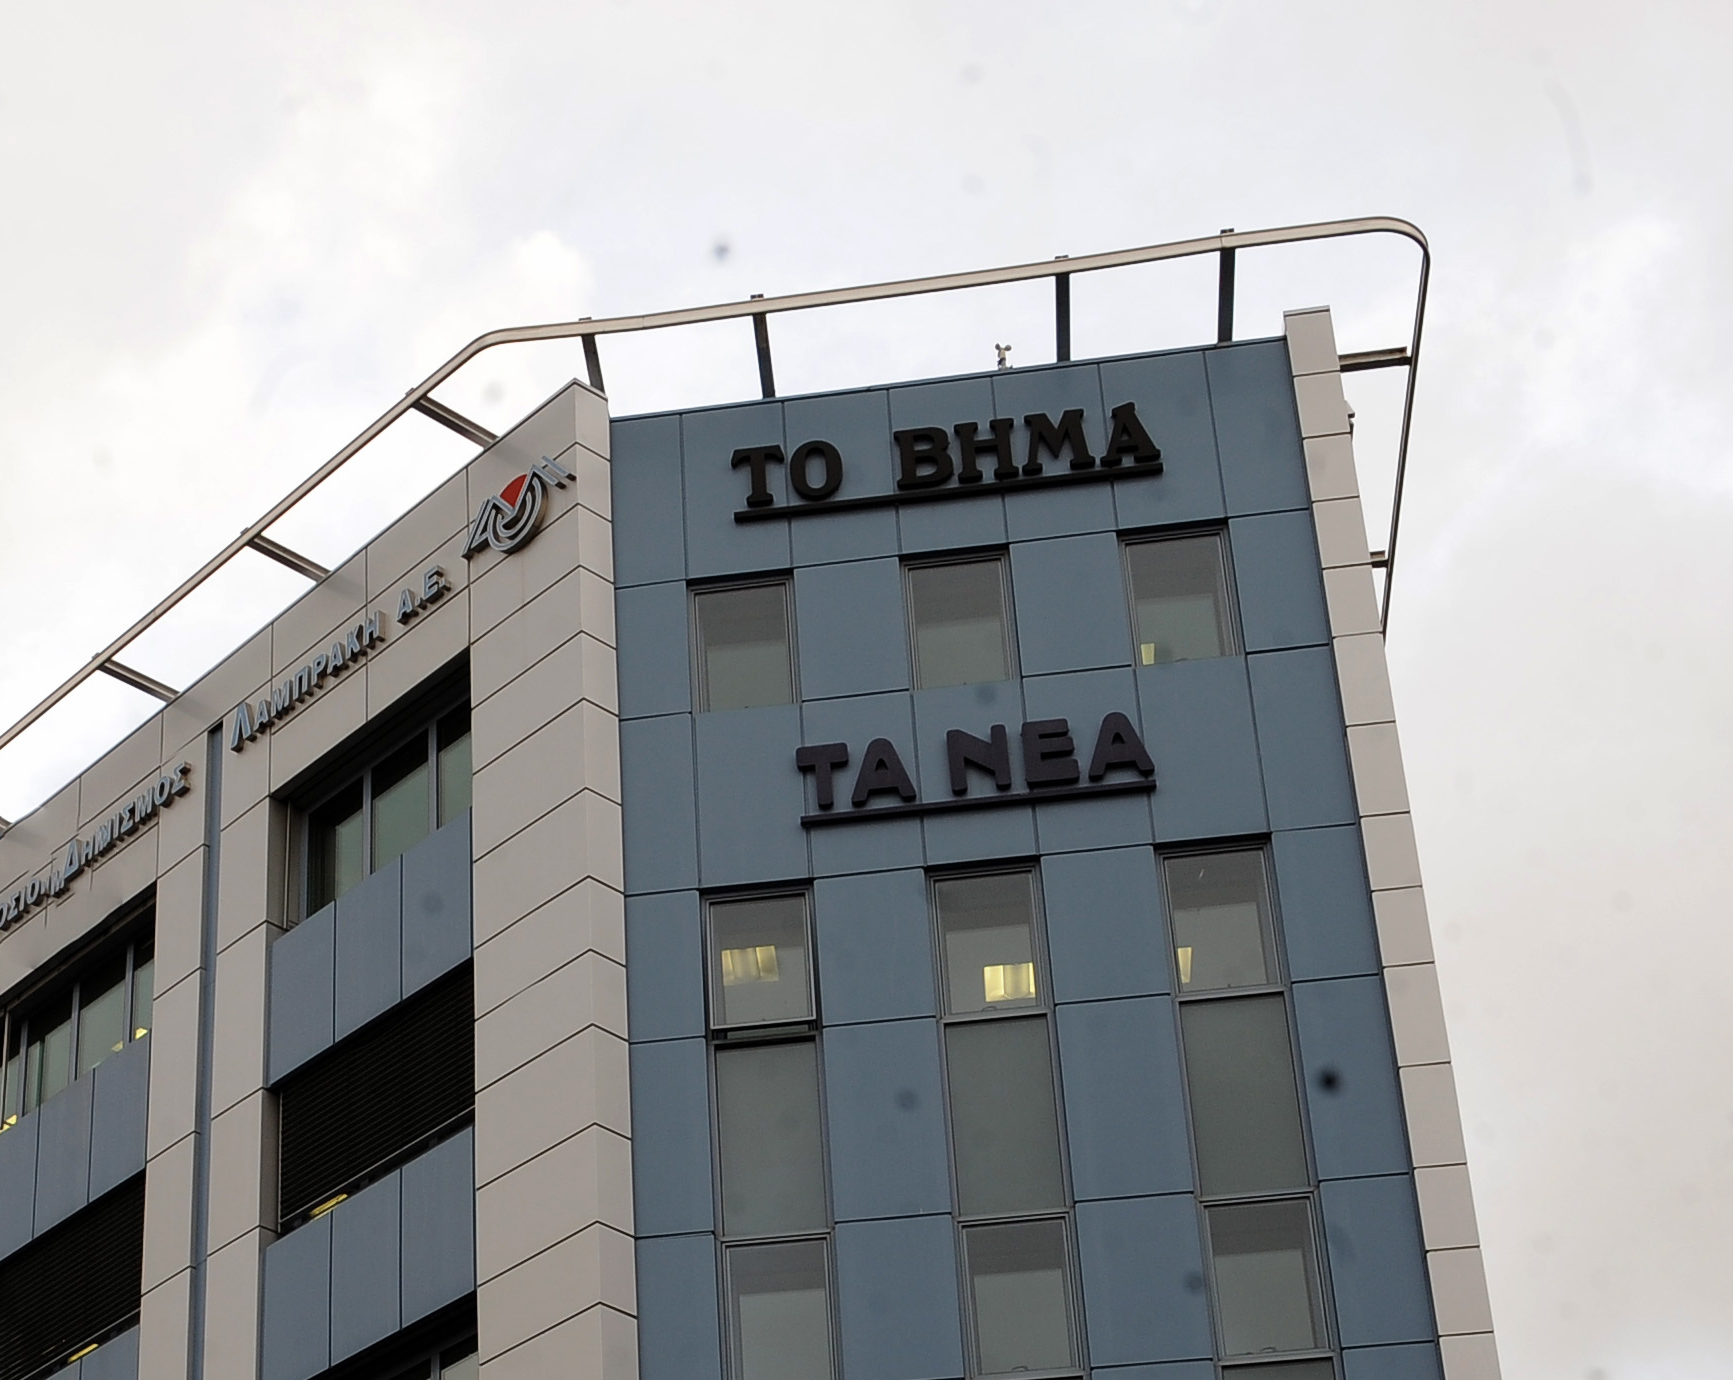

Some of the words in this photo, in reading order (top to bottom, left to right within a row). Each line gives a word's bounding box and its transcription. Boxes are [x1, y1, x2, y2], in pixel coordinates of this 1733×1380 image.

[730, 440, 843, 507] ΤΟ
[892, 402, 1162, 491] ΒΗΜΑ
[229, 609, 387, 753] ΛΑΜΠΡΑΚΗ
[397, 565, 451, 624] Α.Ε.
[795, 738, 917, 809] ΤΑ
[946, 711, 1156, 793] ΝΕΑ
